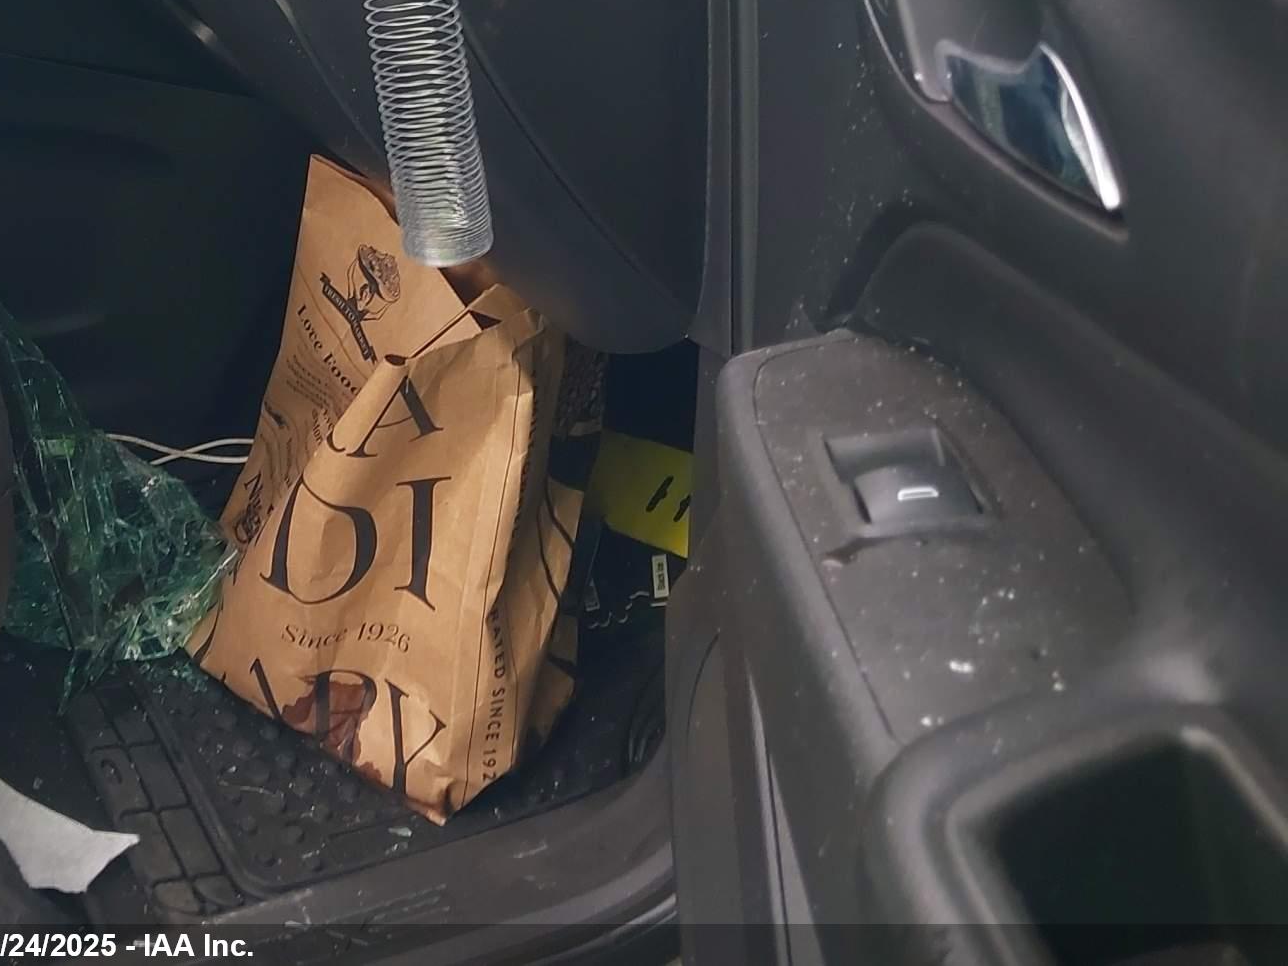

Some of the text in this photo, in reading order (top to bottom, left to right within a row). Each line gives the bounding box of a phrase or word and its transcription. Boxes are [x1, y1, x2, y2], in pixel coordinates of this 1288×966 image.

[280, 621, 412, 654] Since 1926
[485, 687, 506, 740] SINCE
